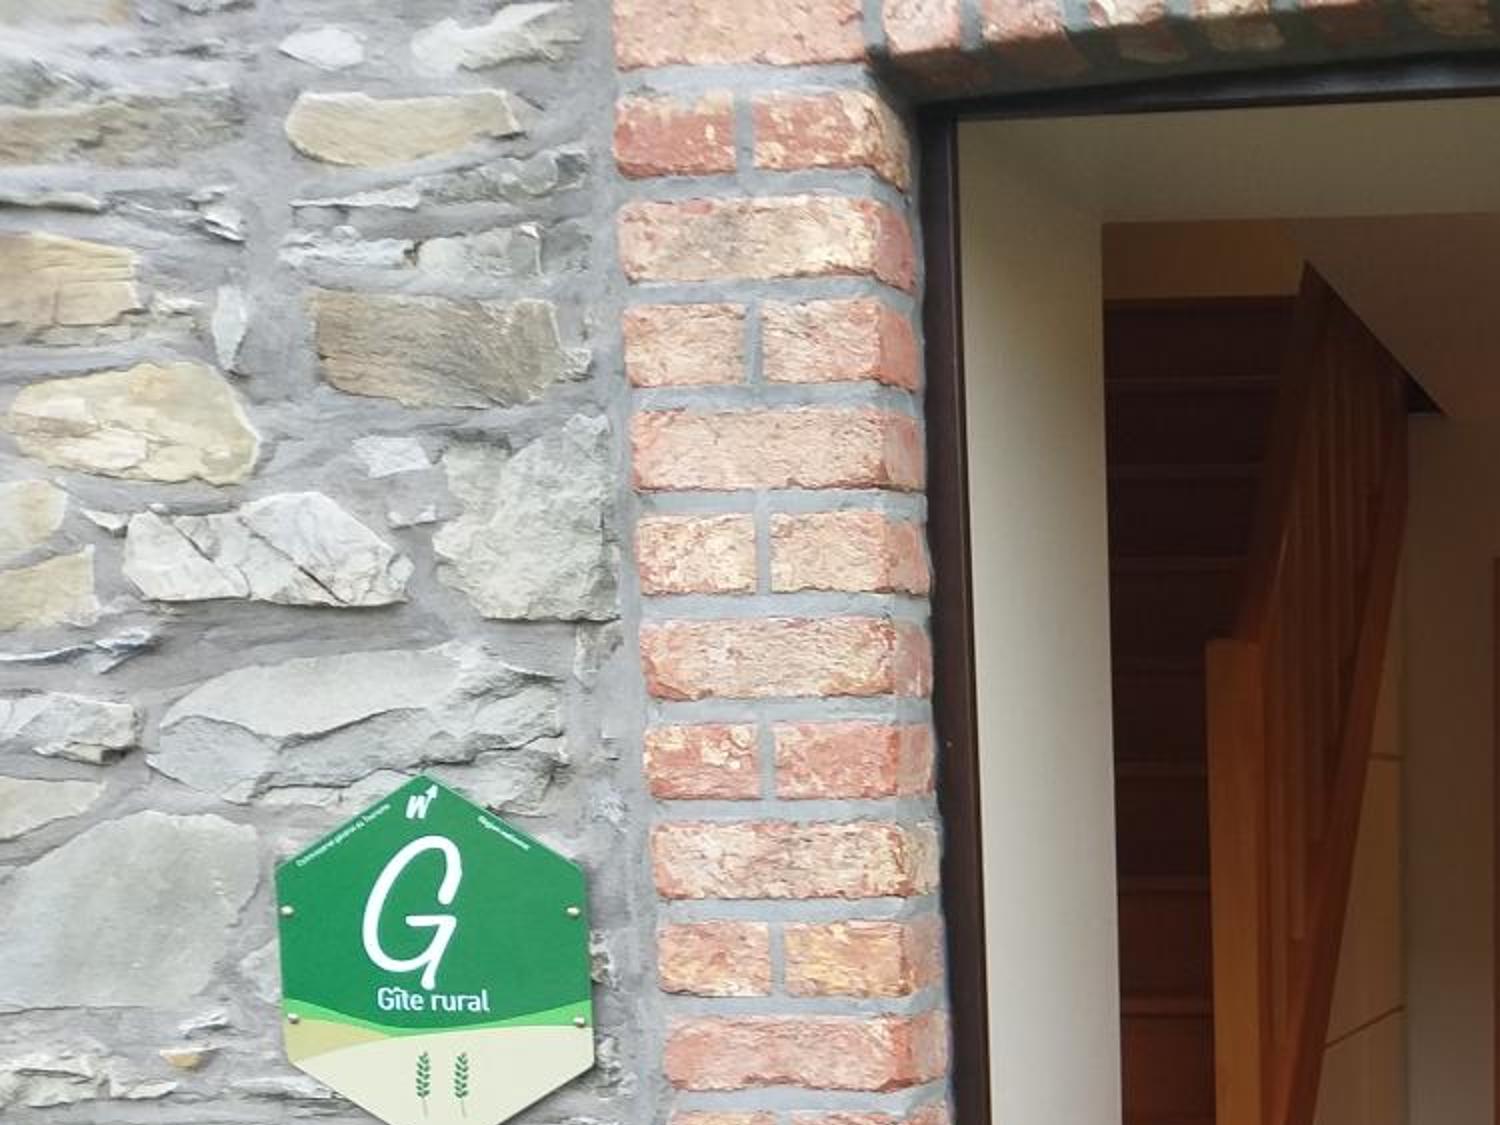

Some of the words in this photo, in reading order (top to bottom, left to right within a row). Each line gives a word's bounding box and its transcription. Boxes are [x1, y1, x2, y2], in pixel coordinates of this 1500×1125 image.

[362, 835, 463, 990] G
[377, 986, 424, 1011] Gîte
[430, 989, 490, 1012] rural
